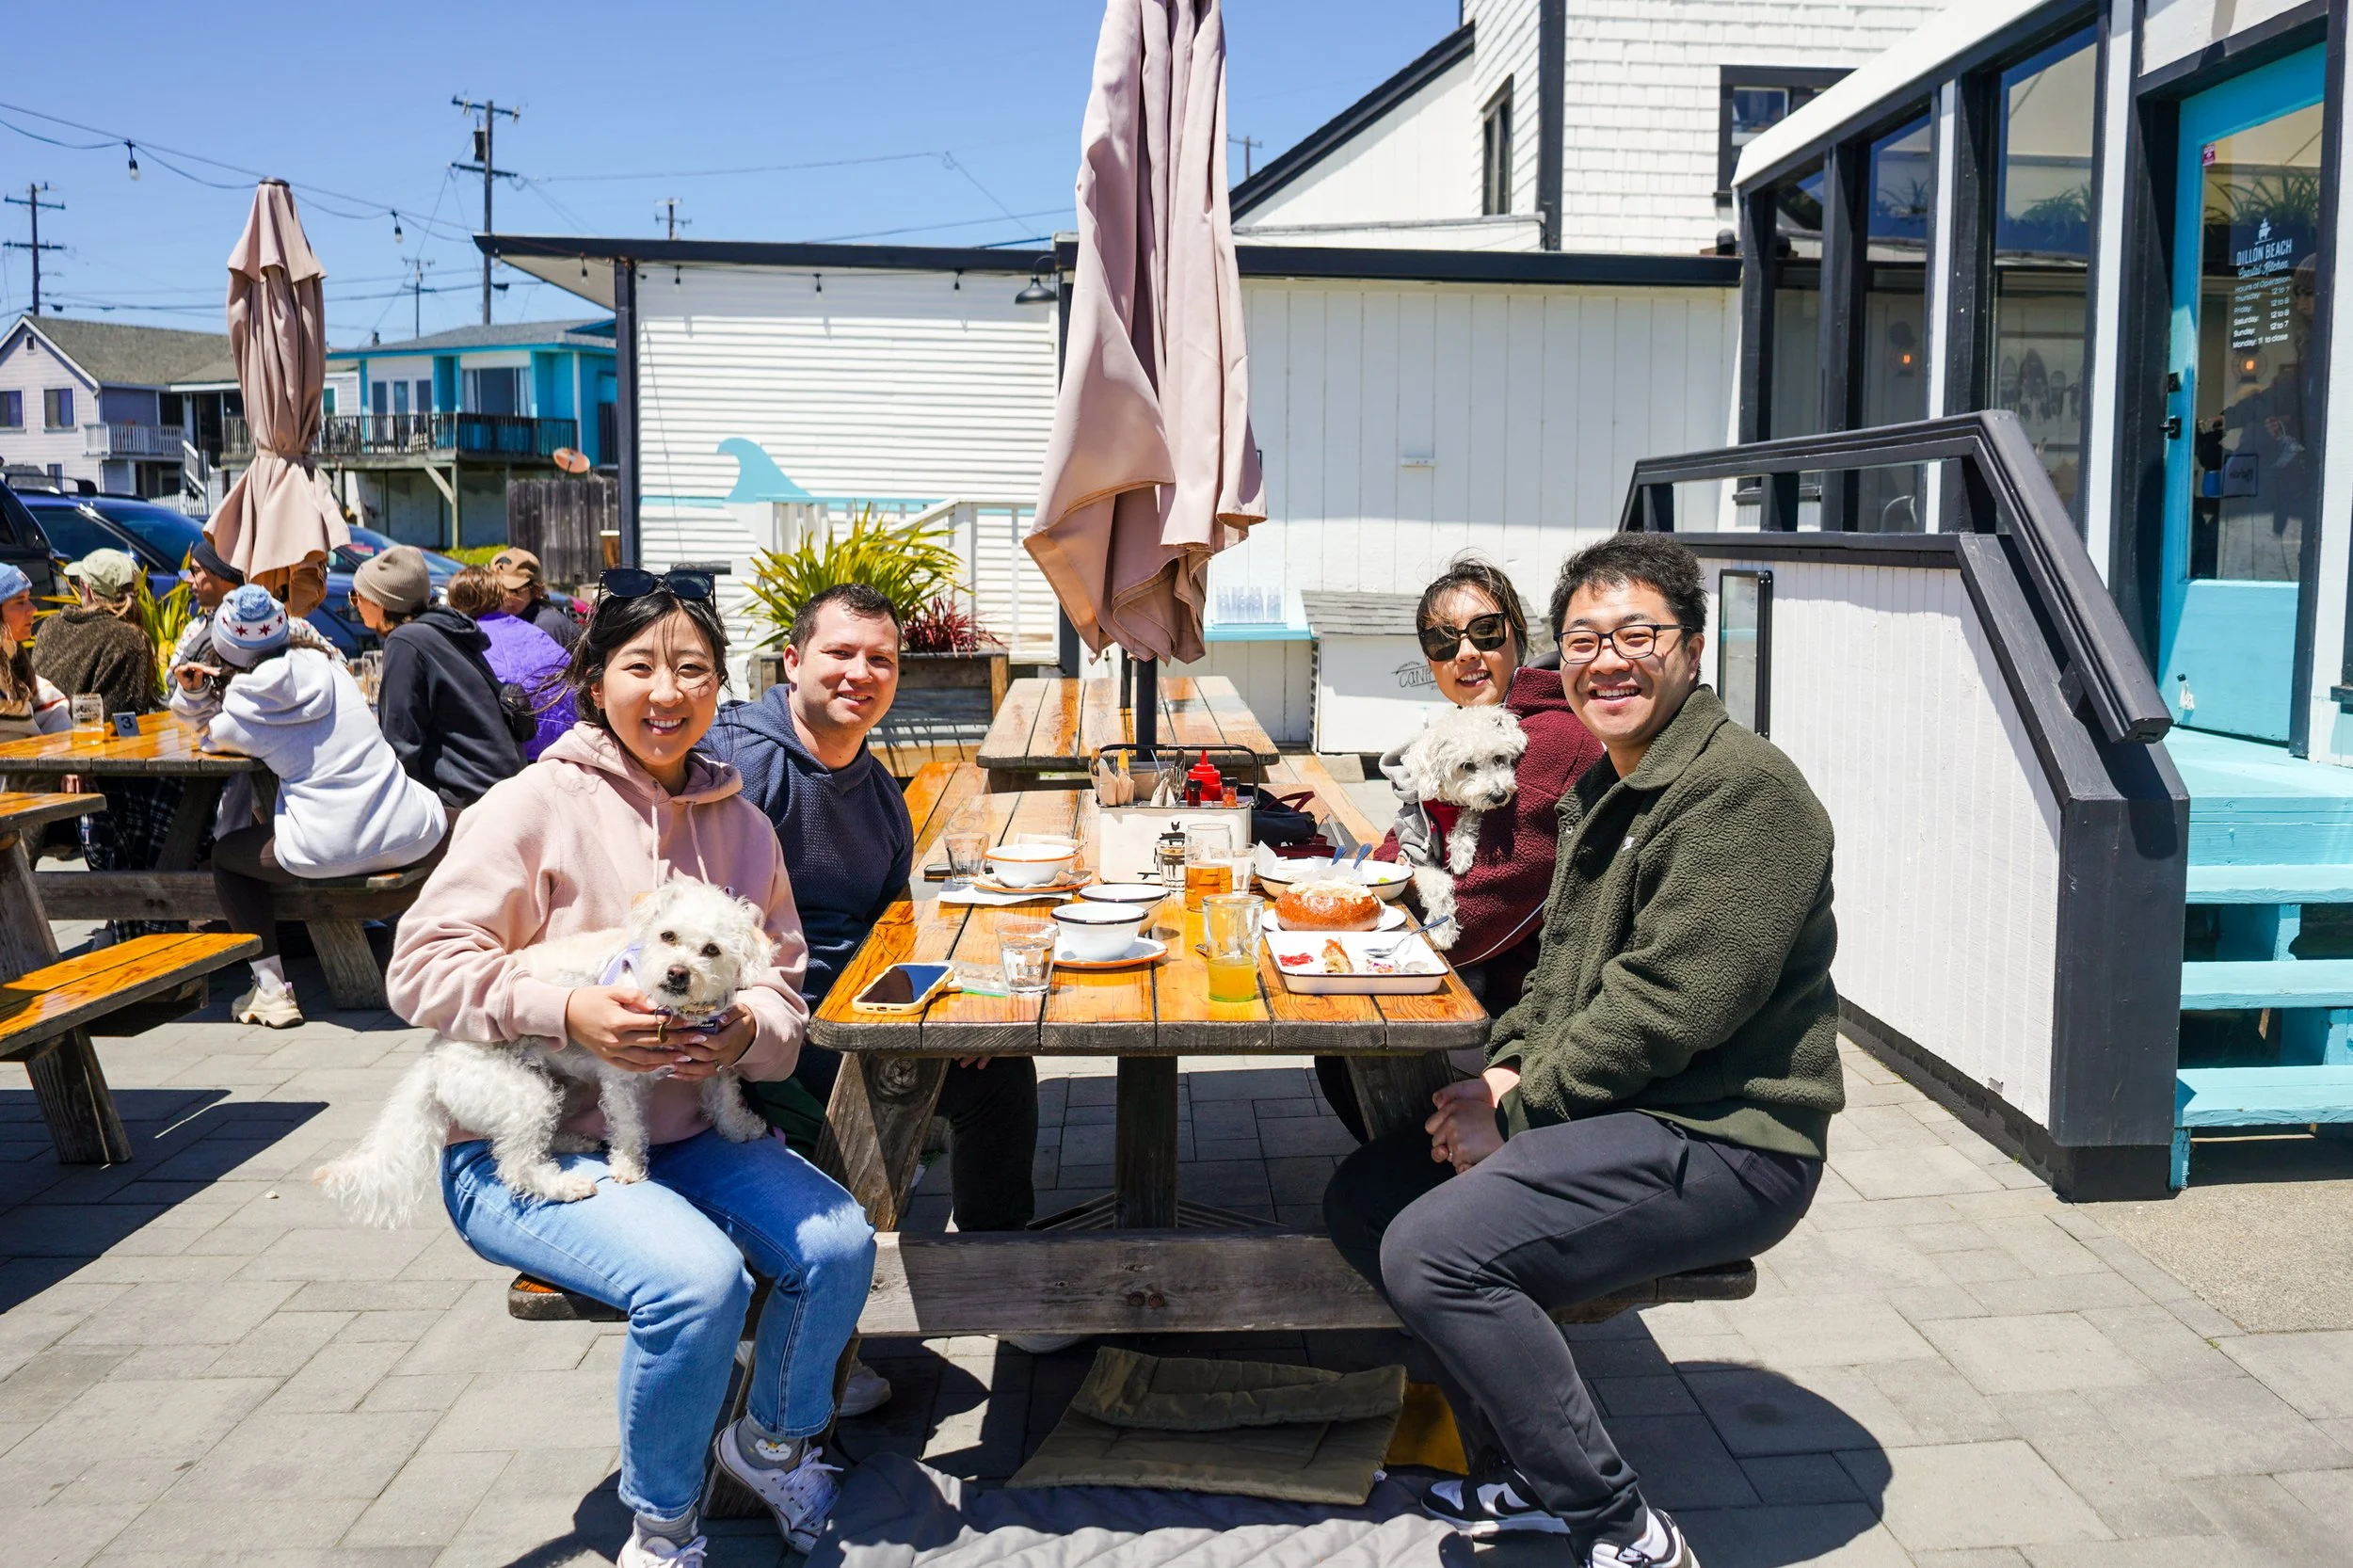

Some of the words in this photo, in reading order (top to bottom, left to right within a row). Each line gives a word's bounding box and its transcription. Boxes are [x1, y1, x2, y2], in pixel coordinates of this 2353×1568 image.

[2236, 246, 2264, 266] DILLON
[2265, 238, 2293, 259] BEACH
[120, 716, 134, 729] 3
